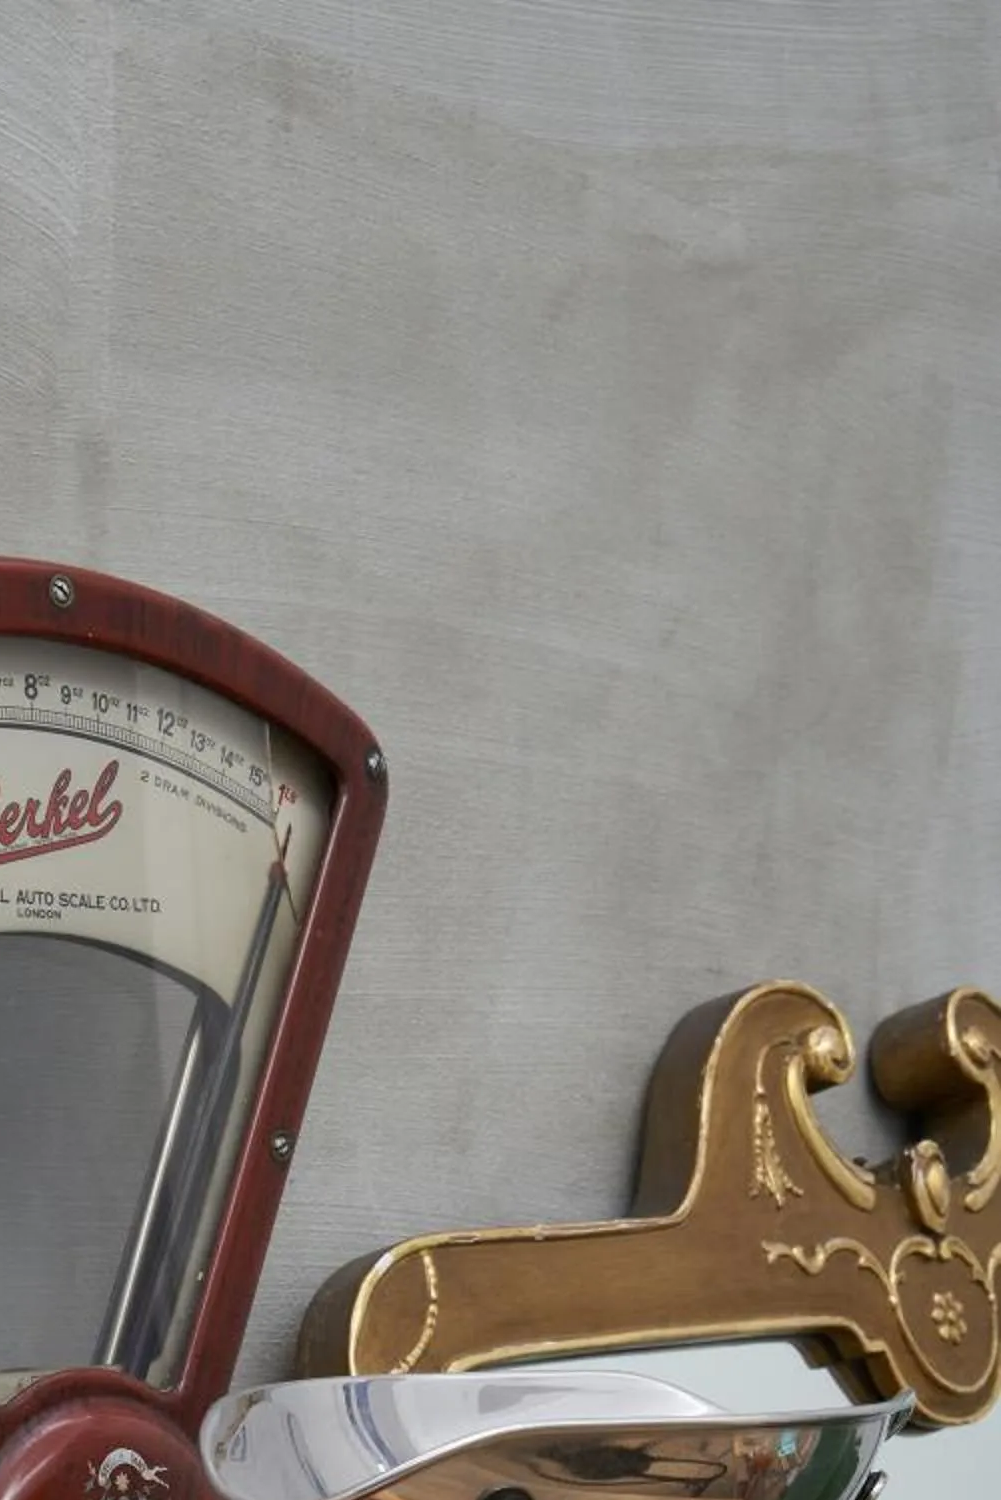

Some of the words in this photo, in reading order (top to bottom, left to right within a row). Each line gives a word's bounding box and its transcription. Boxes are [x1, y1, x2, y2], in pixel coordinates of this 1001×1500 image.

[140, 770, 150, 783] 2
[154, 775, 189, 797] DRAM
[195, 795, 249, 834] DIVISIONS
[16, 889, 55, 906] AUTO
[59, 892, 106, 911] SCALE
[17, 907, 62, 919] LONDON
